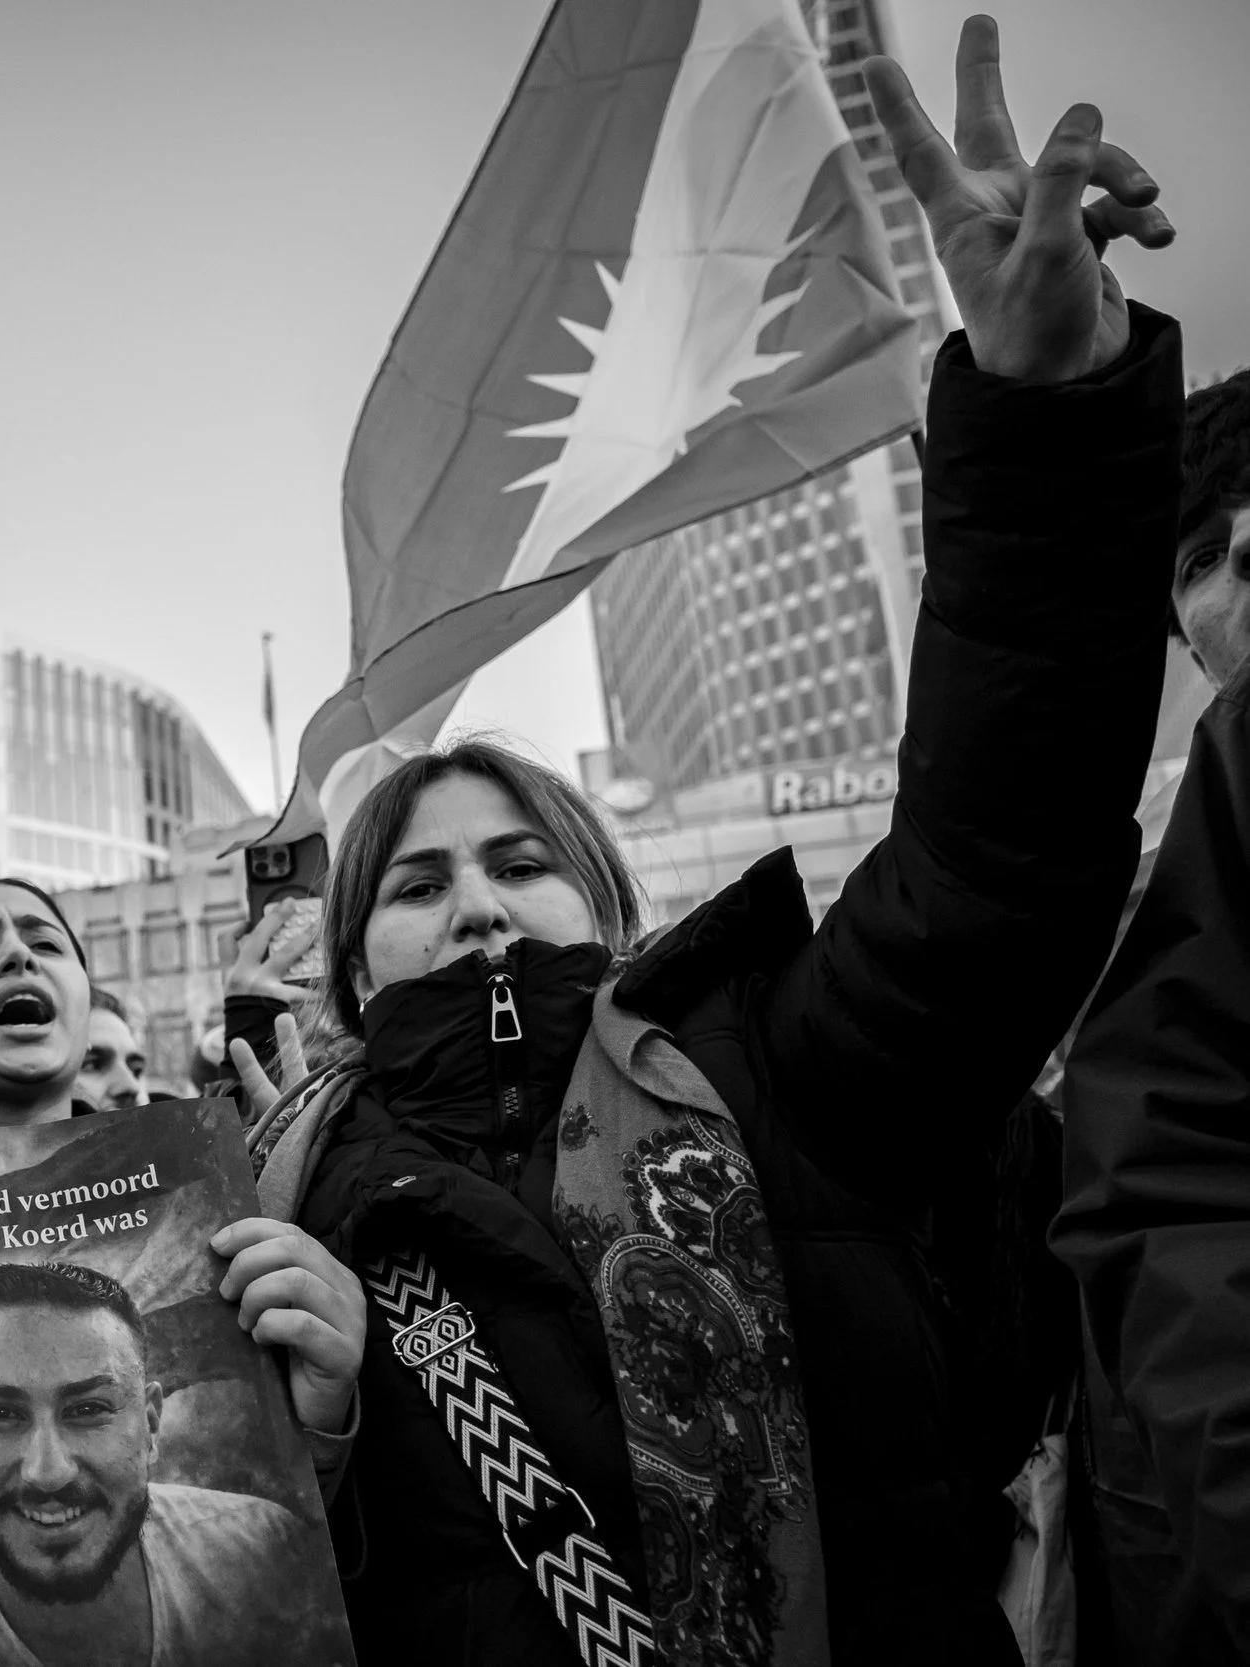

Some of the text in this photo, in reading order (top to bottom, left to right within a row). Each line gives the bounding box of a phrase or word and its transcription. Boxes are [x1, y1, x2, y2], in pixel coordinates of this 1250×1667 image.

[17, 1163, 160, 1212] vermoord
[1, 1214, 89, 1250] Koerd
[93, 1207, 150, 1236] was
